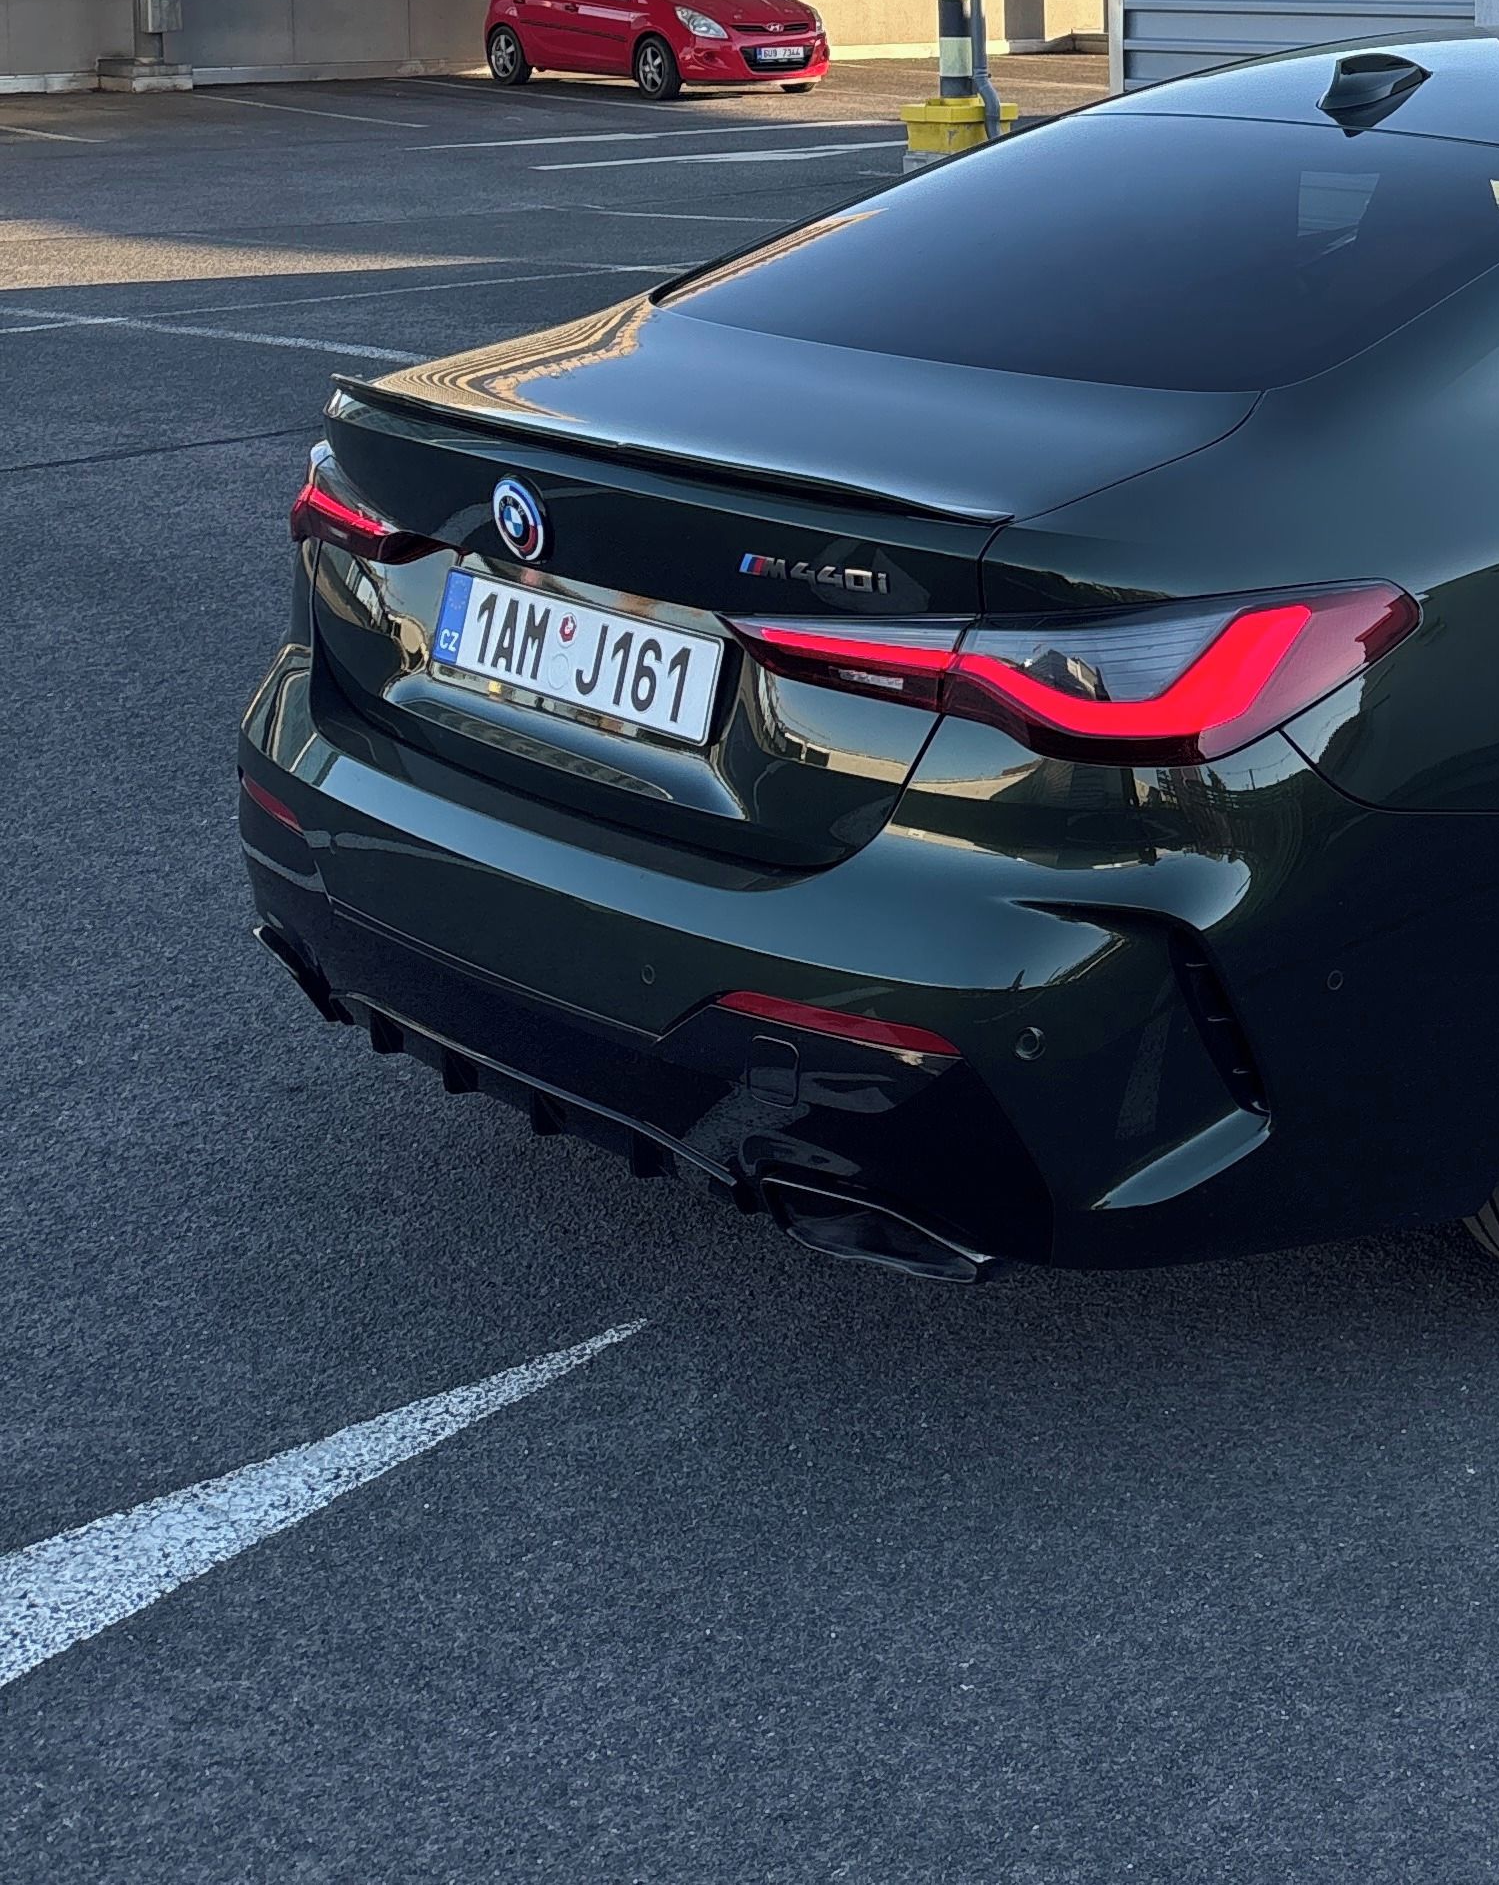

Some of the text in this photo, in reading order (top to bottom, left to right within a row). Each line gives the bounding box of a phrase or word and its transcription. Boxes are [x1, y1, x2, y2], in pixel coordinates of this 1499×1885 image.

[765, 556, 888, 595] M440i
[439, 628, 460, 652] CZ
[477, 592, 692, 723] 1AM J161
